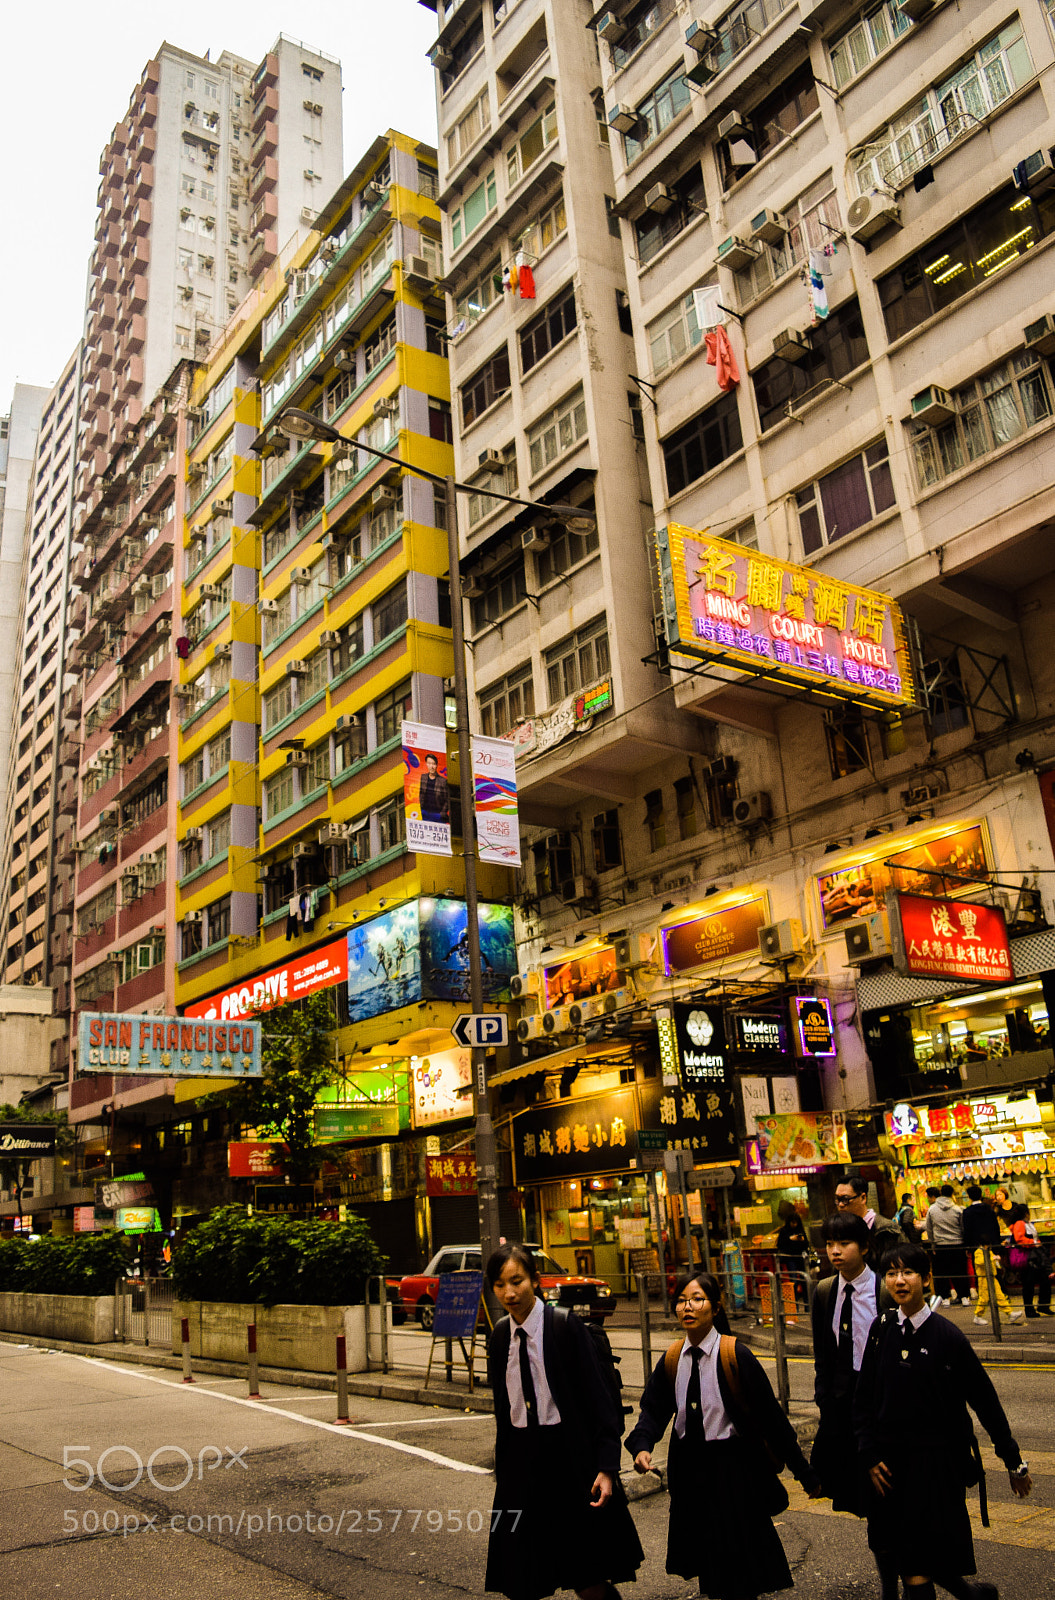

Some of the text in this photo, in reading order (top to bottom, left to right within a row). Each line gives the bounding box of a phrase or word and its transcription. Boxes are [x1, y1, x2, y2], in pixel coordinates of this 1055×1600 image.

[706, 593, 894, 670] MING COURT HOTEL
[475, 751, 492, 766] 20
[486, 819, 510, 829] HONG
[486, 826, 510, 836] KONG
[930, 904, 982, 941] 港豐
[695, 939, 711, 950] CLUB
[710, 932, 736, 947] AVENUE
[221, 969, 288, 1020] PRO-DIVE
[481, 1018, 499, 1042] P
[742, 1018, 779, 1035] Modern
[89, 1019, 255, 1053] SAN FRANCISCO
[743, 1033, 780, 1044] Classic
[88, 1048, 130, 1066] CLUB
[683, 1050, 723, 1067] Modern
[685, 1066, 725, 1078] Classic
[744, 1084, 766, 1099] Nail
